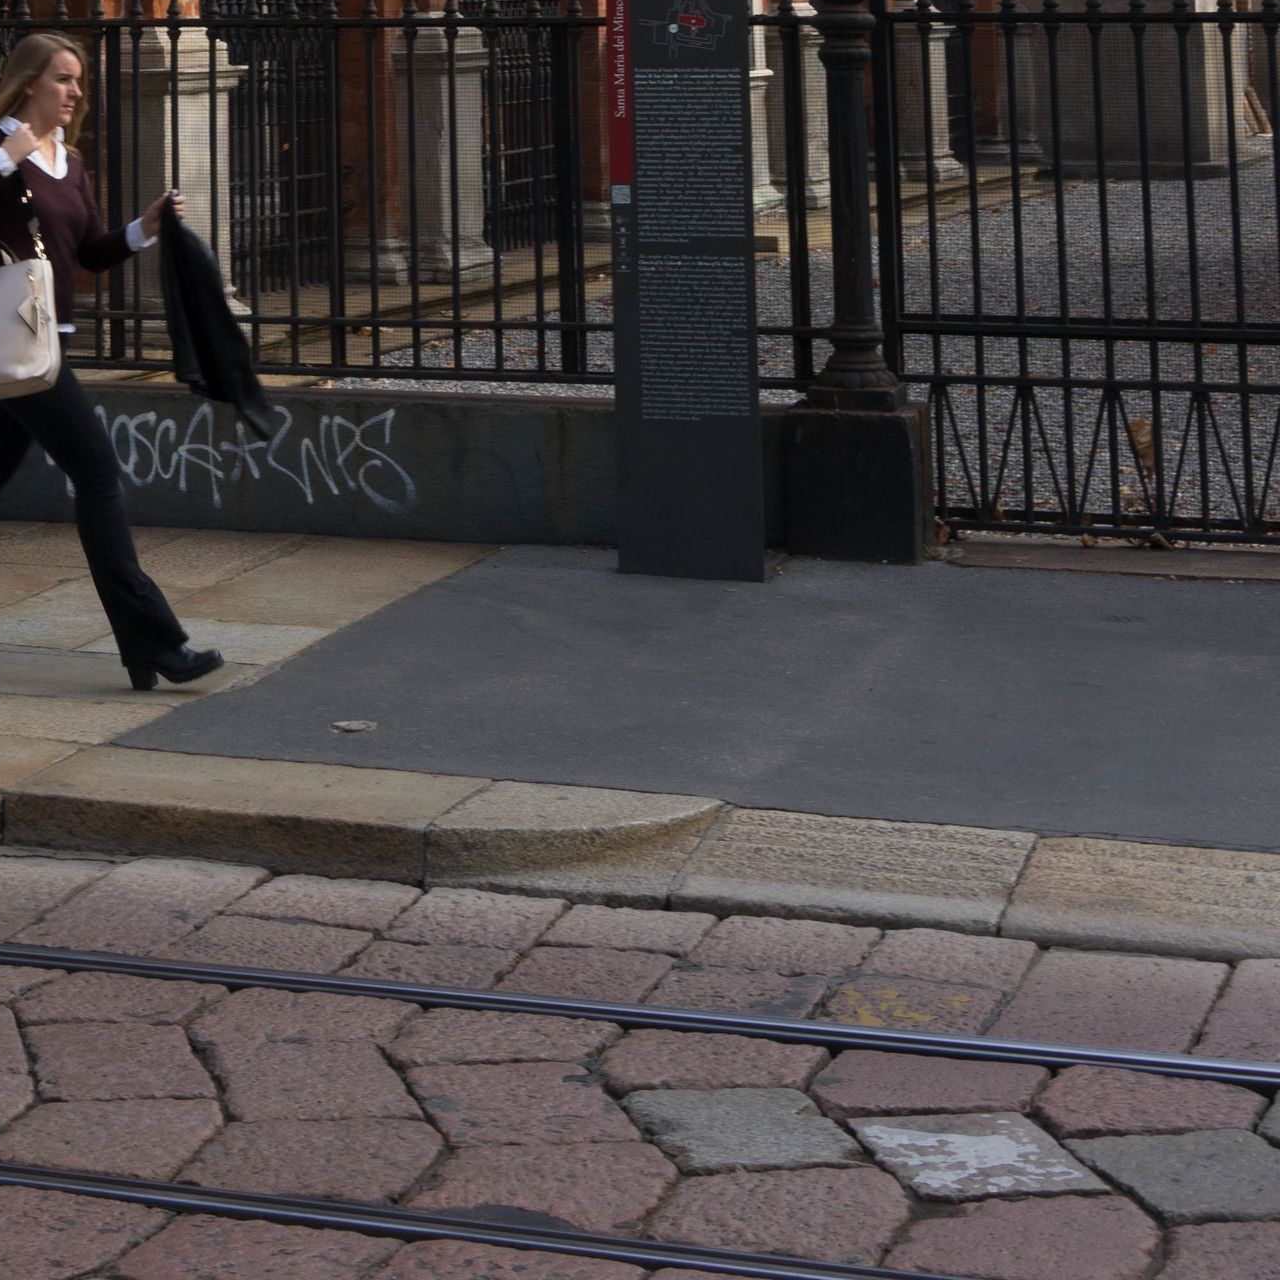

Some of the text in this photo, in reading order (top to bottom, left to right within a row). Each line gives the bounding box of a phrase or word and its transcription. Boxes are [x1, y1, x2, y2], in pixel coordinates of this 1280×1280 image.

[612, 35, 625, 51] dei
[613, 54, 625, 85] Maria
[614, 89, 626, 118] Santa
